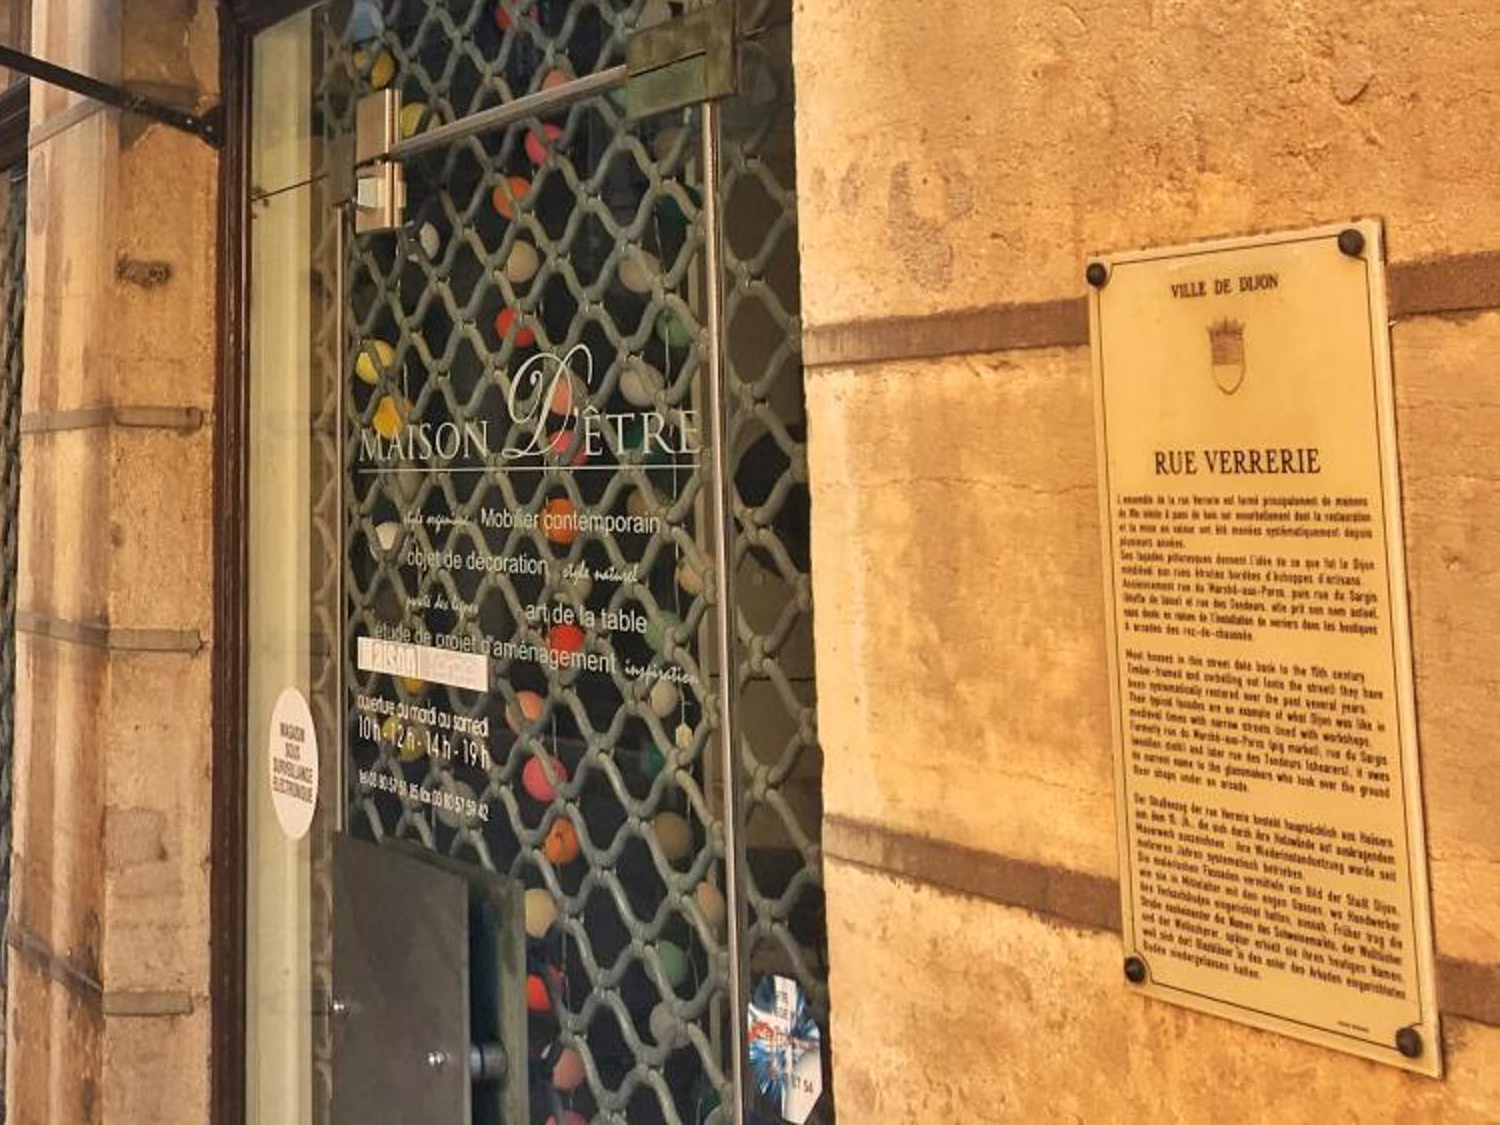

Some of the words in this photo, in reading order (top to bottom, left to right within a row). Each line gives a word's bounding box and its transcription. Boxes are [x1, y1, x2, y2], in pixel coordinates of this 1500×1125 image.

[1171, 281, 1206, 298] VILLE
[1214, 278, 1232, 295] DE
[1239, 273, 1279, 292] DIJON
[359, 421, 487, 461] MAISON
[1155, 450, 1197, 475] RUE
[1204, 448, 1321, 474] VERRERIE
[481, 507, 539, 530] Mobilier
[543, 510, 661, 536] contemporain
[407, 546, 439, 571] objet
[443, 550, 462, 570] de
[526, 604, 550, 625] art
[552, 603, 574, 625] de
[579, 605, 595, 628] la
[601, 609, 647, 634] table
[414, 627, 432, 647] de
[359, 715, 371, 740] 10
[373, 718, 381, 742] h
[390, 722, 404, 748] 12
[406, 727, 415, 752] h
[425, 731, 439, 758] 14
[442, 735, 452, 761] h
[463, 738, 478, 767] 19
[480, 744, 491, 772] h
